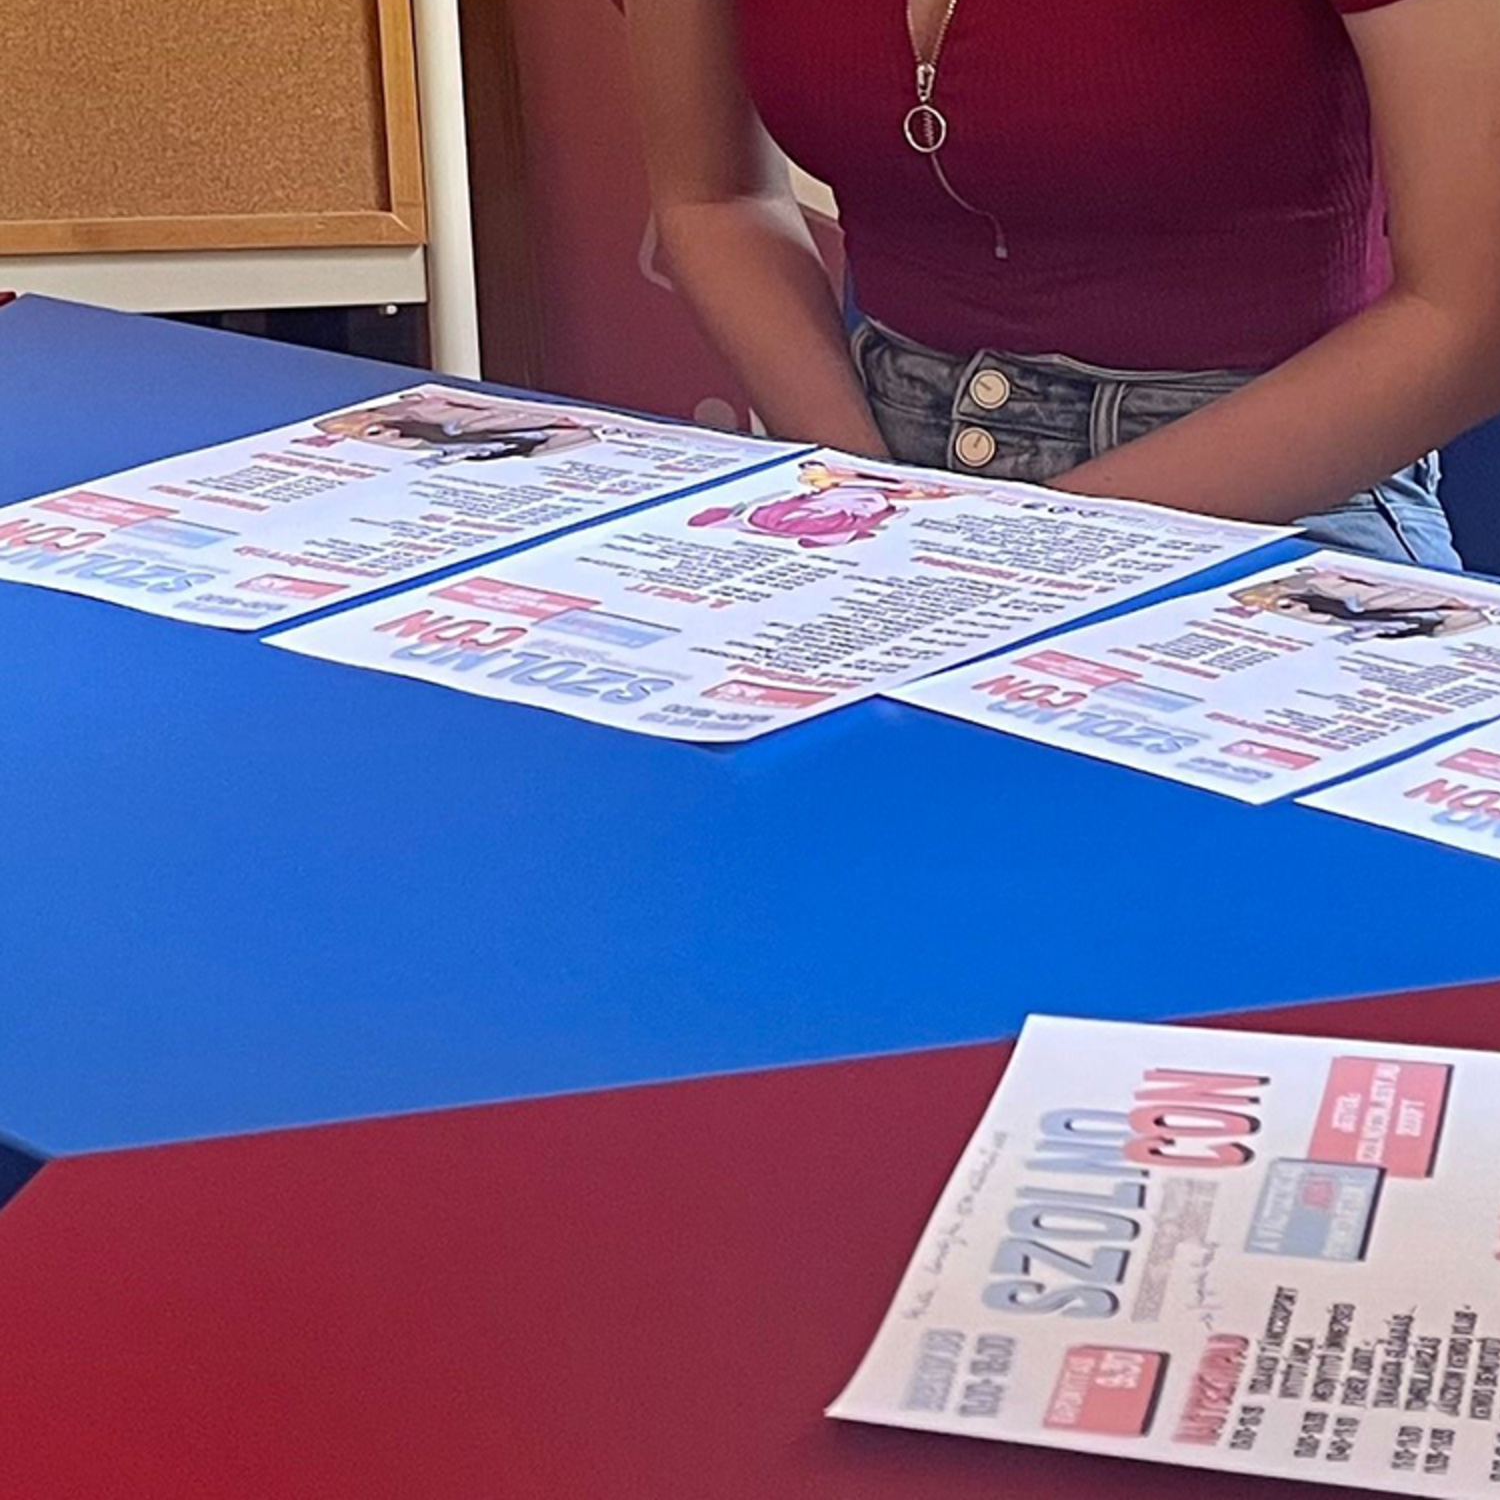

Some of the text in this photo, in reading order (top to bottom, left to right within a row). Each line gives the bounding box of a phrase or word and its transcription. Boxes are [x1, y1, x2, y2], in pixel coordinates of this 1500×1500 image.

[373, 609, 529, 651] CON
[971, 674, 1088, 709] CON
[1123, 1066, 1271, 1169] CON
